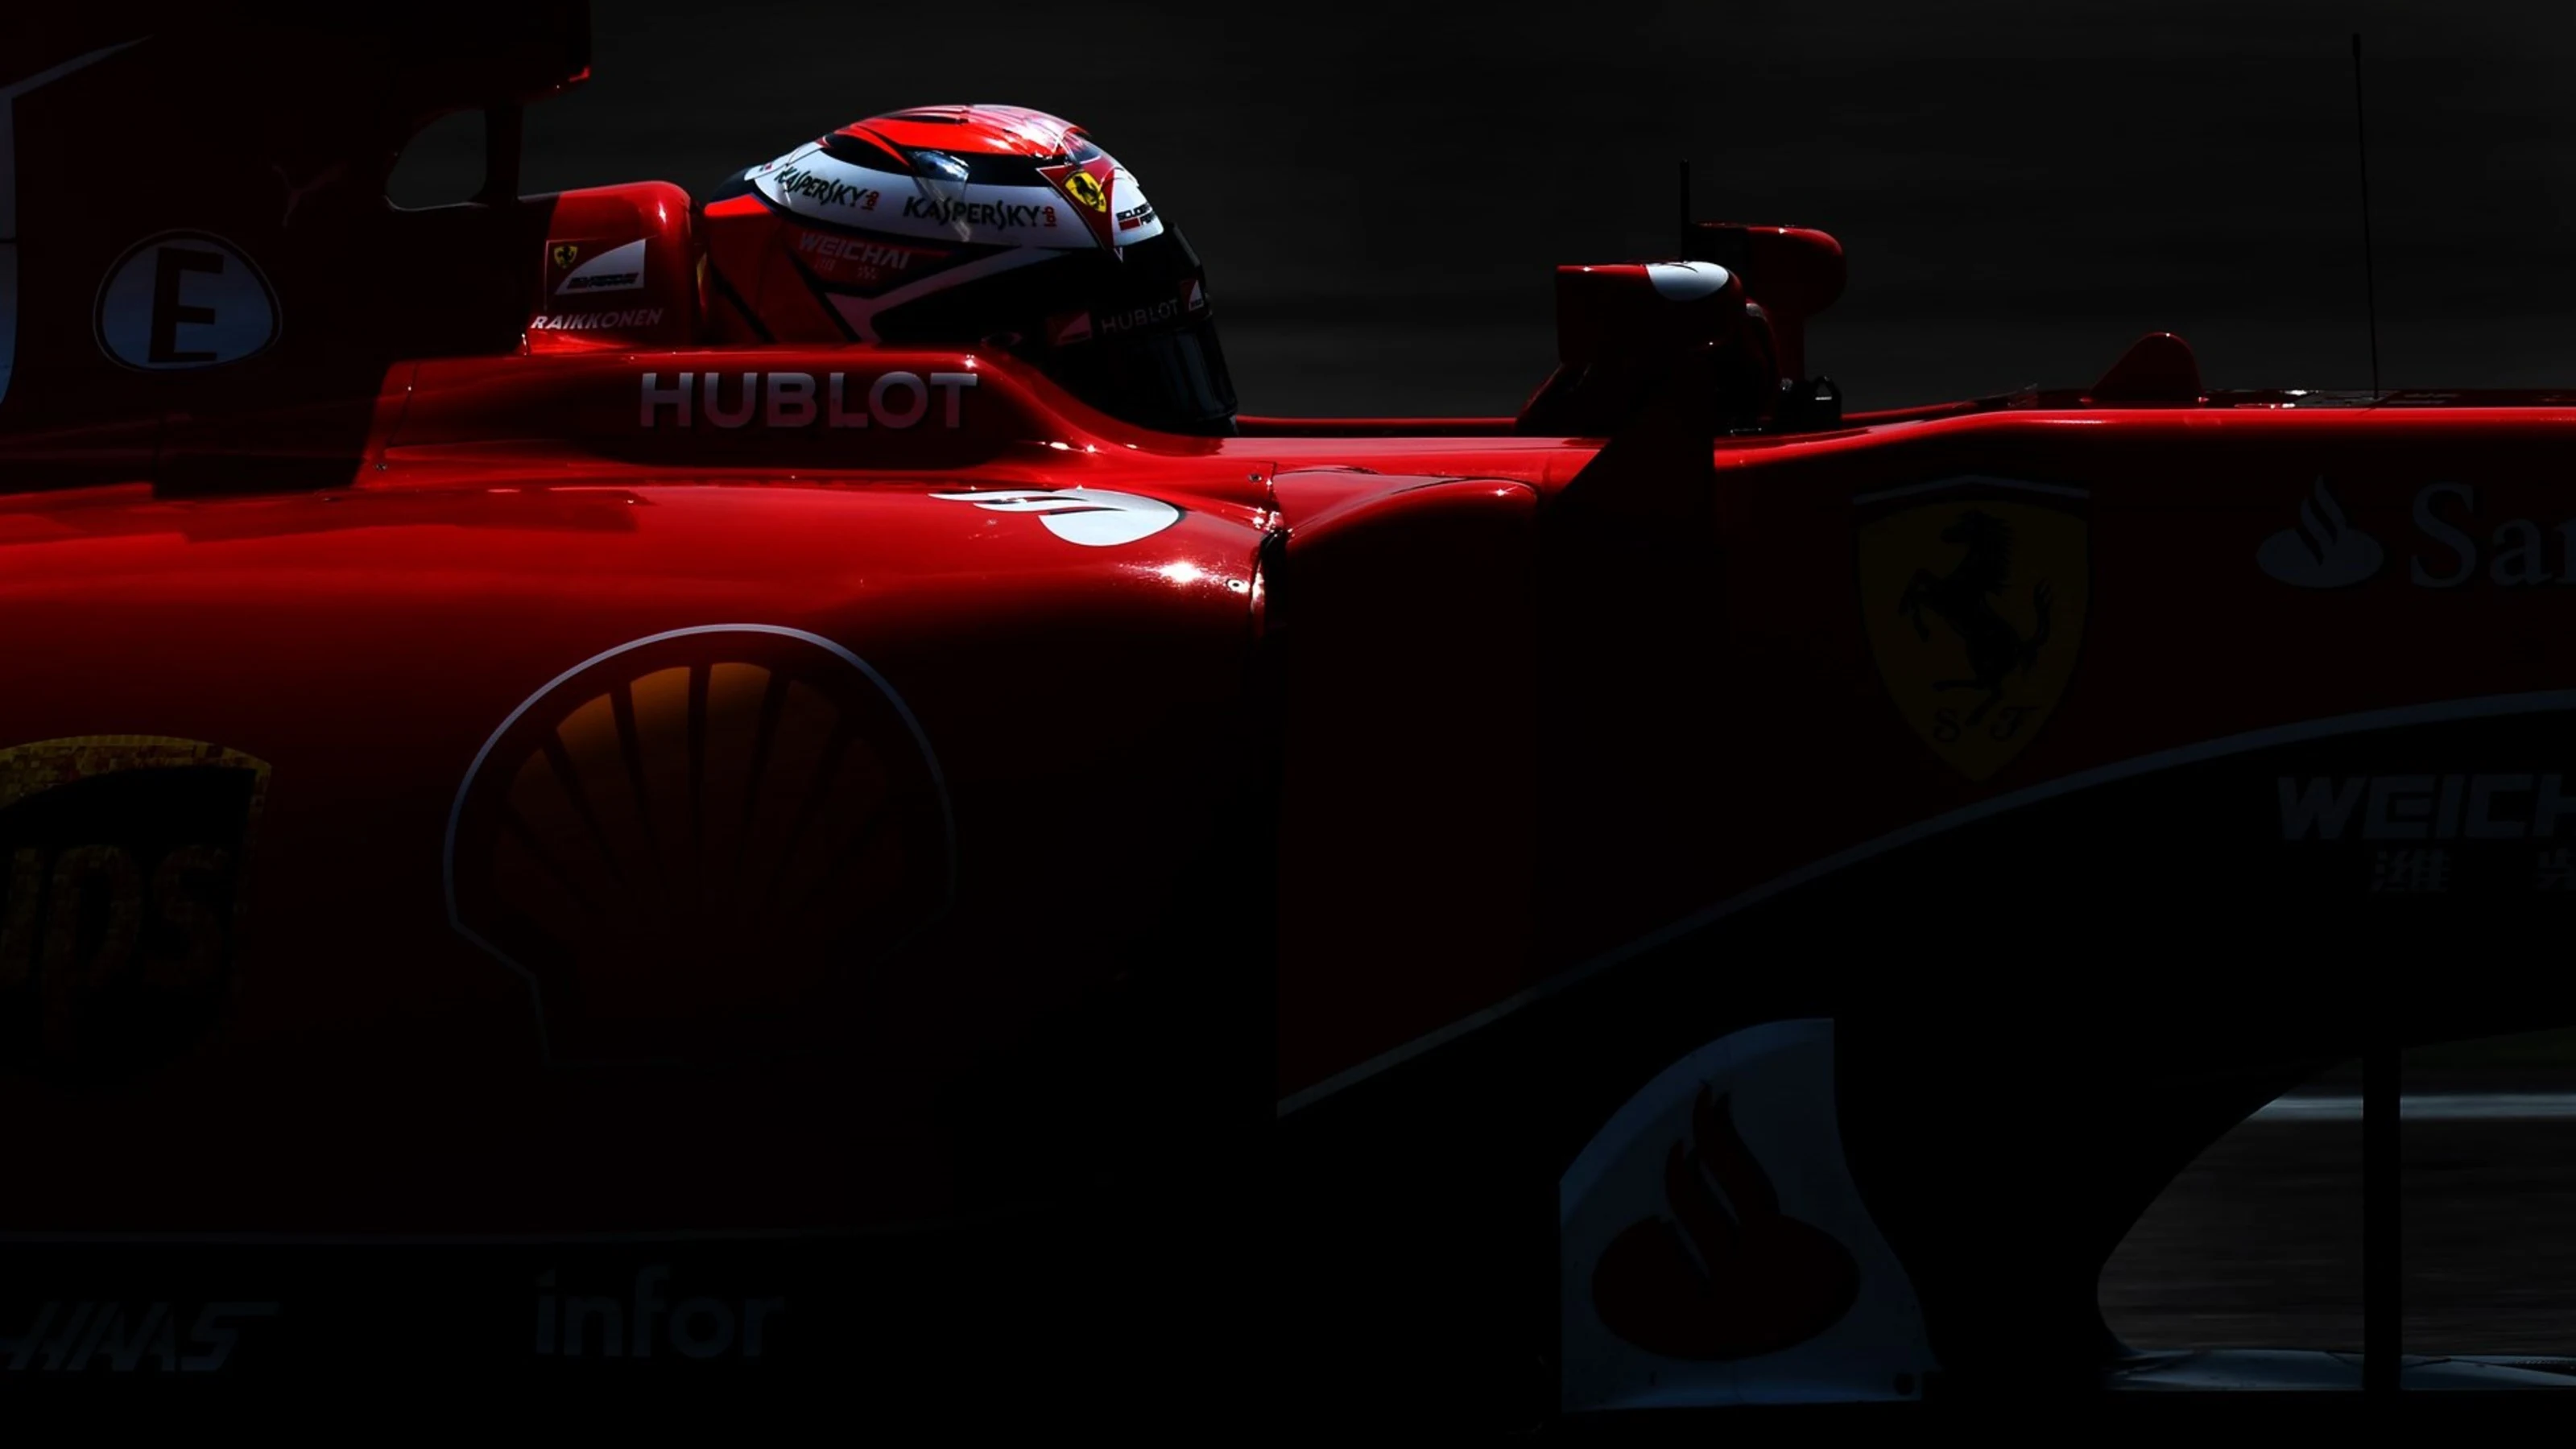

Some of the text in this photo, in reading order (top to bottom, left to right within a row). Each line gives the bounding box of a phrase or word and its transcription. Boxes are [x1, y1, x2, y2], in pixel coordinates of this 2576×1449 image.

[774, 166, 866, 207] KASPERSKY
[903, 196, 1040, 230] KASPERSKY
[798, 229, 912, 270] WEICHAI
[149, 248, 223, 361] E
[531, 308, 665, 331] RAIKKONEN
[1100, 296, 1178, 336] HUBLOT
[640, 371, 978, 429] HUBLOT
[533, 1261, 788, 1360] infor
[0, 1298, 282, 1373] HAAS
